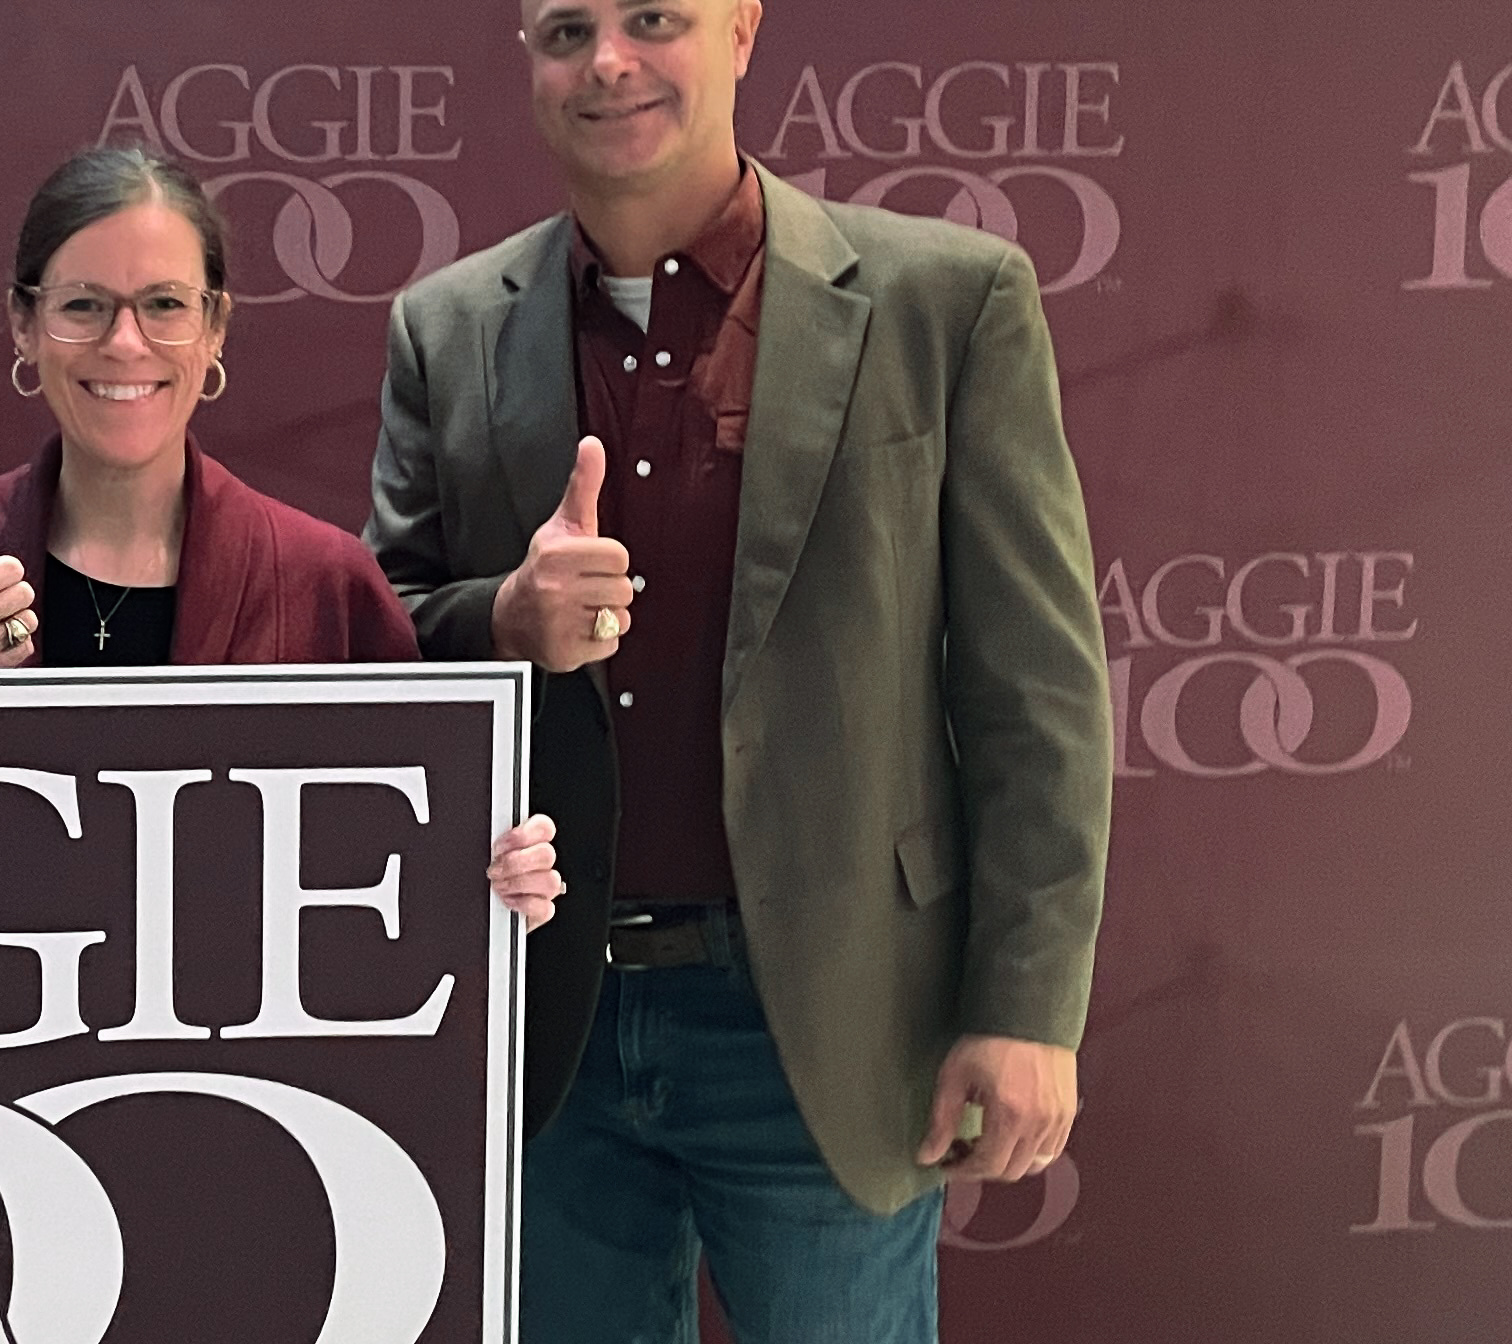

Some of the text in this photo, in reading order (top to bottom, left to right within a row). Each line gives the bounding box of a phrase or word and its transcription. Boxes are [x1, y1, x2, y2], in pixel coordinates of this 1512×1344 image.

[94, 62, 461, 163] AGGIE
[757, 61, 1126, 159] AGGIE
[198, 170, 460, 304] 00
[1097, 551, 1419, 648] AGGIE
